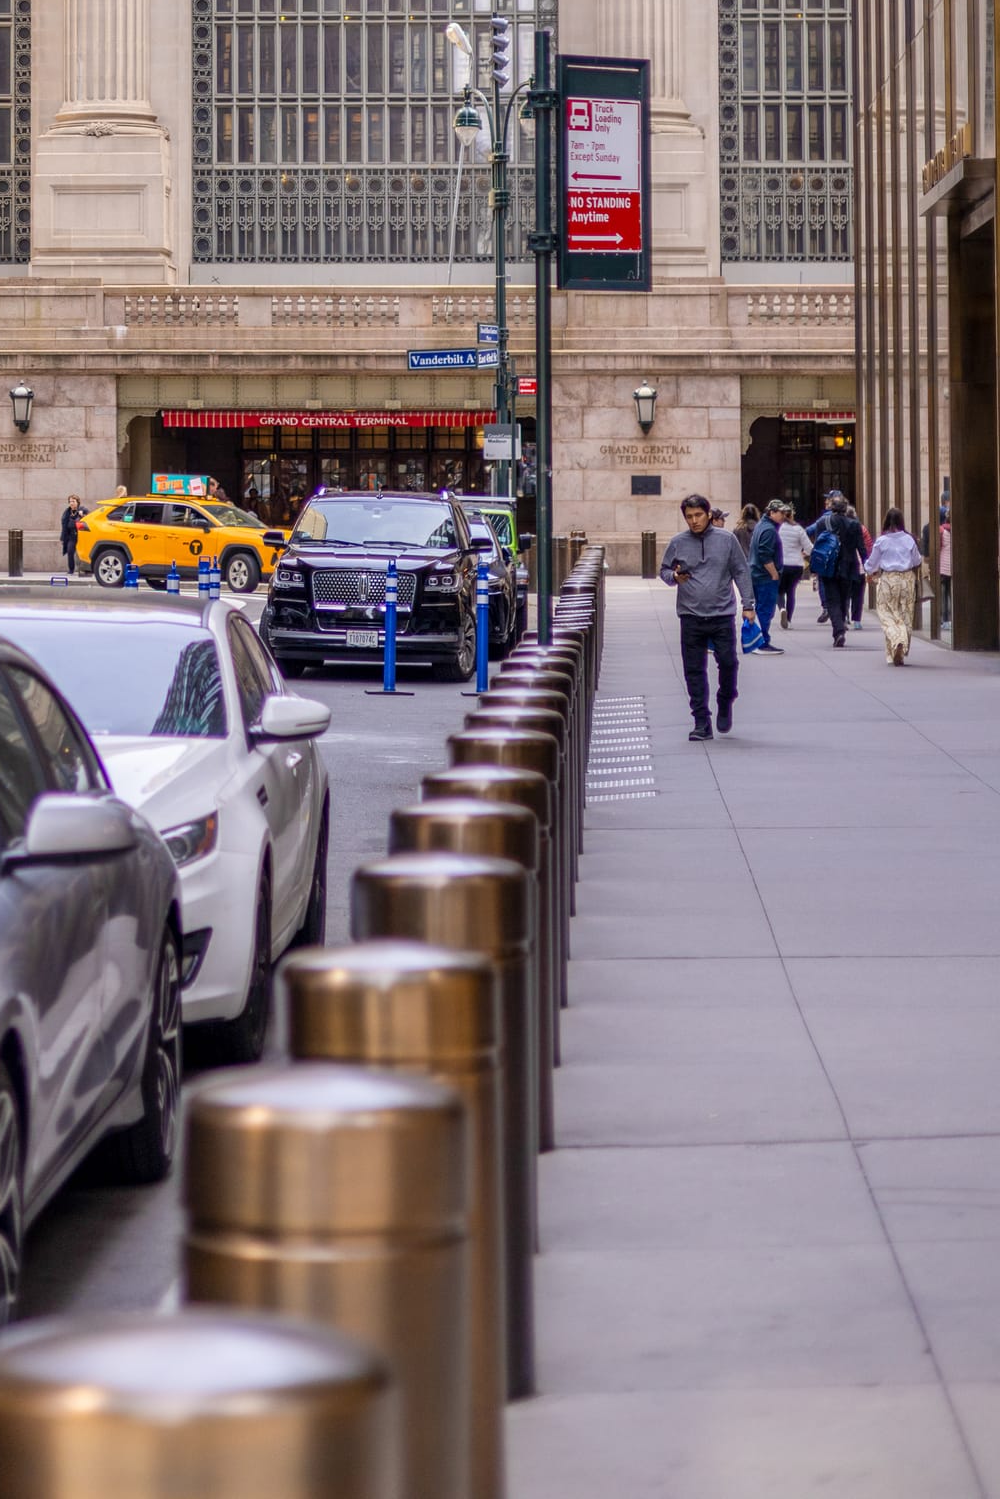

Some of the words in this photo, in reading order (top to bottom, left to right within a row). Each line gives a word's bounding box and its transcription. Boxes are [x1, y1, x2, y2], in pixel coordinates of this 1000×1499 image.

[594, 104, 614, 113] Truck
[594, 114, 622, 124] Loading
[594, 123, 611, 134] Only
[571, 140, 585, 150] 7am
[591, 141, 606, 151] 7pm
[570, 152, 594, 162] Except
[595, 152, 620, 164] Sunday
[570, 196, 584, 208] NO
[586, 197, 631, 209] STANDING
[571, 210, 610, 225] Anytime
[411, 354, 465, 365] Vanderbilt
[259, 416, 299, 426] GRAND
[301, 416, 351, 426] CENTRAL
[353, 416, 409, 426] TERMINAL
[19, 443, 69, 453] CENTRAL
[599, 445, 639, 454] GRAND
[641, 445, 692, 454] CENTRAL
[617, 455, 675, 464] TERMINAL
